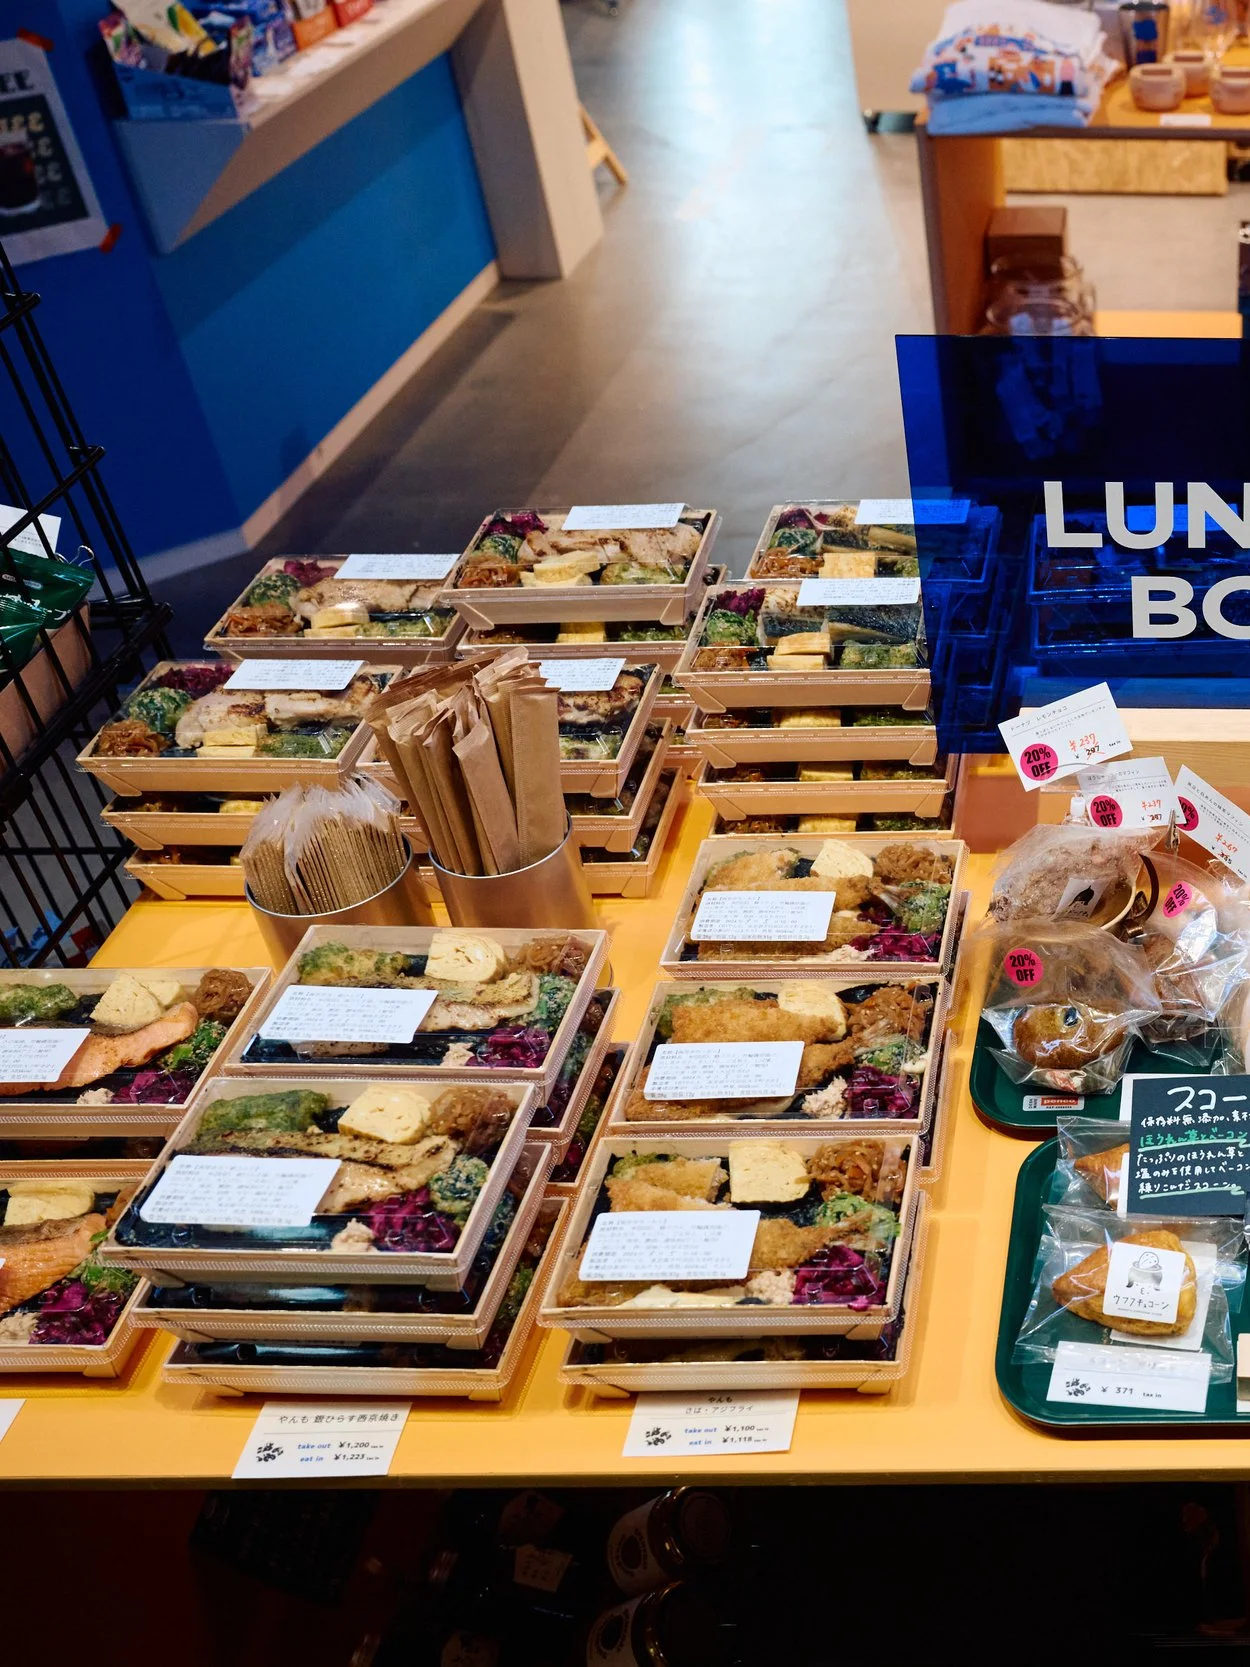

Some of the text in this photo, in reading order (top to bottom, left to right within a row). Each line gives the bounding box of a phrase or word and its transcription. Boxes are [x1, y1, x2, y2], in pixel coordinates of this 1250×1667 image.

[1023, 744, 1052, 765] 20%
[1031, 760, 1052, 779] OFF
[1093, 799, 1116, 814] 20%
[1099, 811, 1117, 827] OFF
[1172, 883, 1190, 907] 20%
[1164, 898, 1178, 914] OFF
[1009, 954, 1036, 968] 20%
[1015, 969, 1035, 982] OFF
[1140, 1127, 1248, 1147] ほうれん草とベーコン
[1137, 1146, 1245, 1167] たっぷりのほうれん草と
[1115, 1386, 1133, 1395] 371
[279, 1415, 309, 1424] やんも
[338, 1441, 370, 1449] ¥1,200
